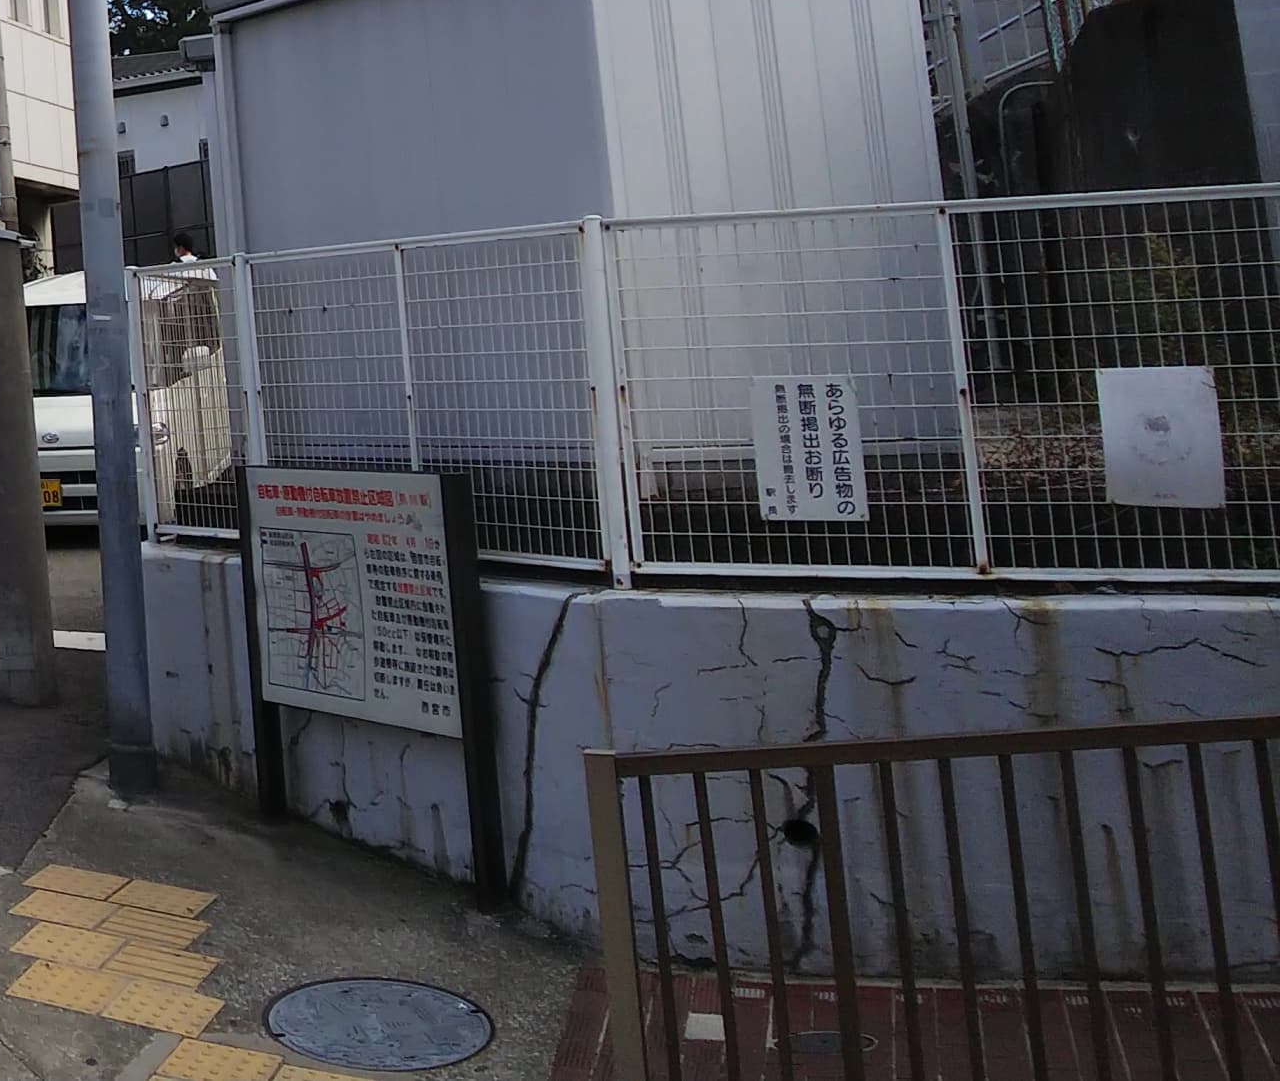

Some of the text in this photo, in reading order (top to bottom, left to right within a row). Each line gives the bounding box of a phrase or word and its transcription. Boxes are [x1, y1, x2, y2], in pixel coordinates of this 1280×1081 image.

[797, 383, 824, 499] 無断掲出お断り
[825, 383, 856, 515] あらゆる広告物の
